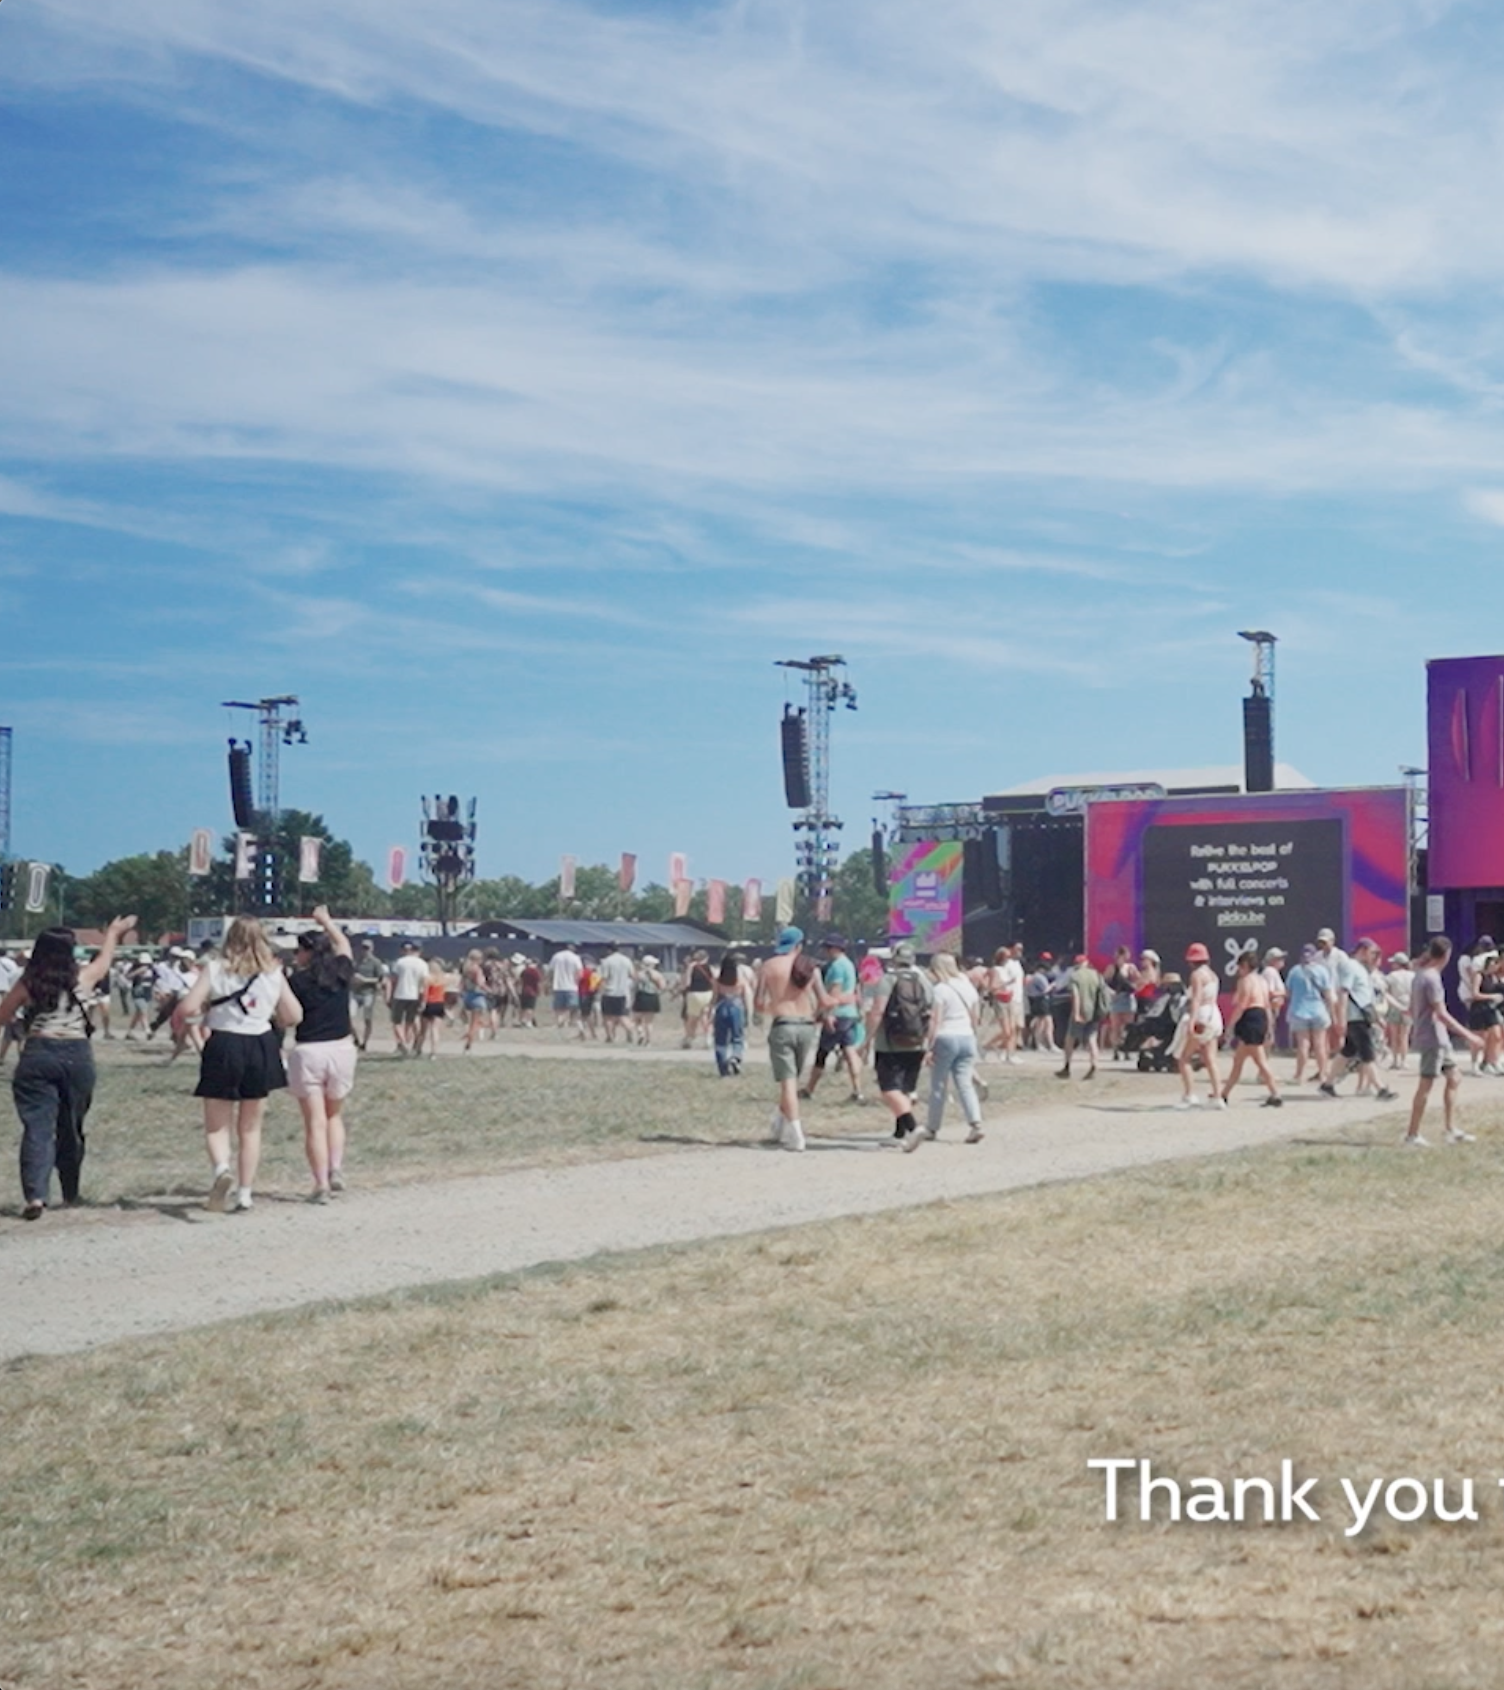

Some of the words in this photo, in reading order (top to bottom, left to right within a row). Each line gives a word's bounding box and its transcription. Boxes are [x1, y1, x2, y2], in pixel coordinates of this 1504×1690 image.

[1227, 843, 1248, 856] the
[1250, 843, 1277, 855] best
[1279, 842, 1293, 855] of
[1189, 878, 1214, 890] with
[1216, 878, 1236, 890] full
[1238, 878, 1289, 890] concerts
[1267, 895, 1285, 906] on
